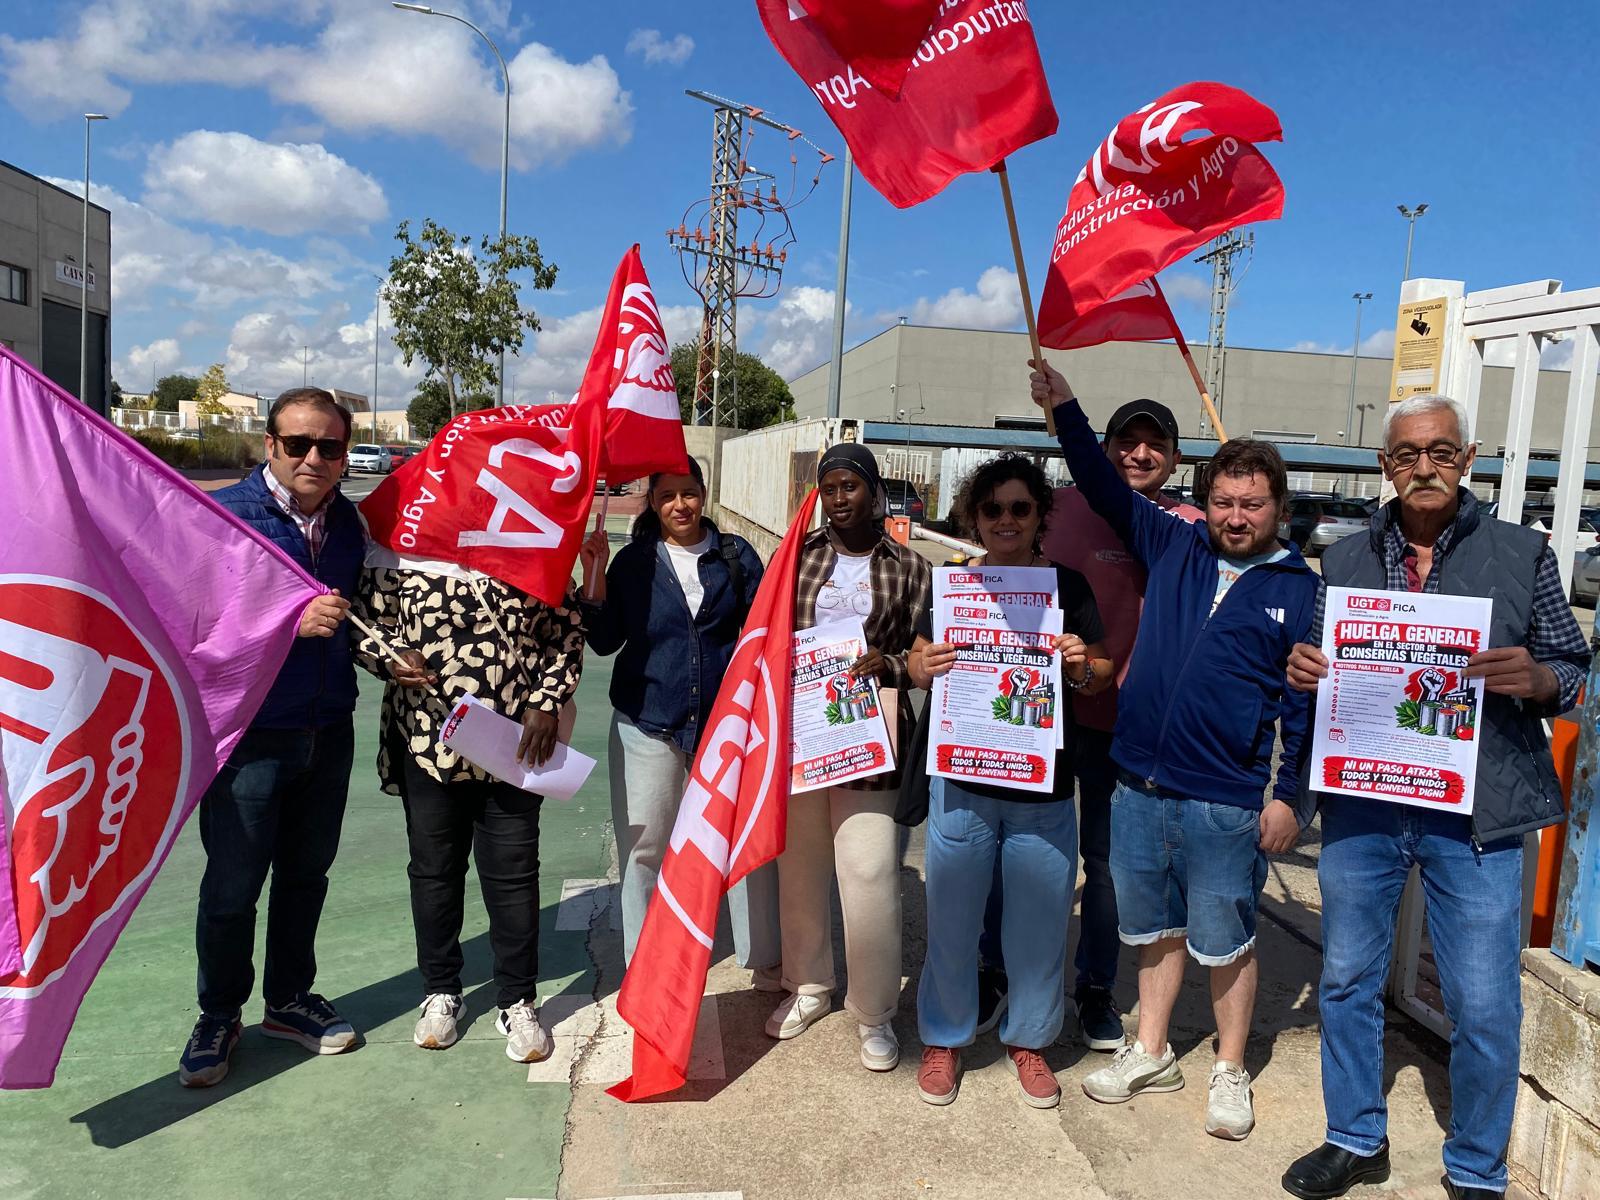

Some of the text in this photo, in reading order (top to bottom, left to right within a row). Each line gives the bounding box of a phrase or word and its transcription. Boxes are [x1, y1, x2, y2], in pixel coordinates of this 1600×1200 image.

[1053, 136, 1239, 264] Construcción y Agro
[63, 265, 95, 285] CAYSR
[426, 467, 446, 483] y
[400, 486, 437, 548] Agro
[951, 574, 971, 583] UGT
[1350, 597, 1416, 613] UGT FICA
[955, 608, 1008, 620] UGT FICA
[800, 636, 816, 645] FICA
[949, 629, 1053, 649] HUELGA GENERAL
[1340, 623, 1475, 647] HUELGA GENERAL
[1397, 642, 1425, 651] SECTOR
[812, 660, 829, 669] SECTOR
[1002, 653, 1048, 666] VEGETALES
[1342, 646, 1469, 667] CONSERVAS VEGETALES
[795, 660, 854, 685] SERVAS VEGETALE
[953, 747, 962, 756] NI
[964, 749, 976, 758] UN
[978, 751, 998, 760] PASO
[804, 763, 812, 771] NI
[814, 759, 824, 767] UN
[826, 754, 842, 764] PASO
[804, 768, 823, 779] TODOS
[830, 759, 849, 771] TODAS
[851, 752, 873, 764] UNIDOS
[951, 758, 973, 766] TODOS
[982, 760, 1004, 769] TODAS
[1006, 763, 1033, 771] UNIDOS
[1344, 760, 1356, 770] NI
[1359, 761, 1374, 771] UN
[1377, 763, 1403, 774] PASO
[807, 777, 817, 785] POR
[819, 774, 827, 782] UN
[830, 766, 854, 779] CONVENIO
[977, 768, 1008, 777] CONVENIO
[1011, 771, 1032, 779] DIGNO
[1341, 771, 1447, 789] TODOS Y TODAS UNIDOS
[1342, 780, 1445, 798] POR UN CONVENIO DIGNO
